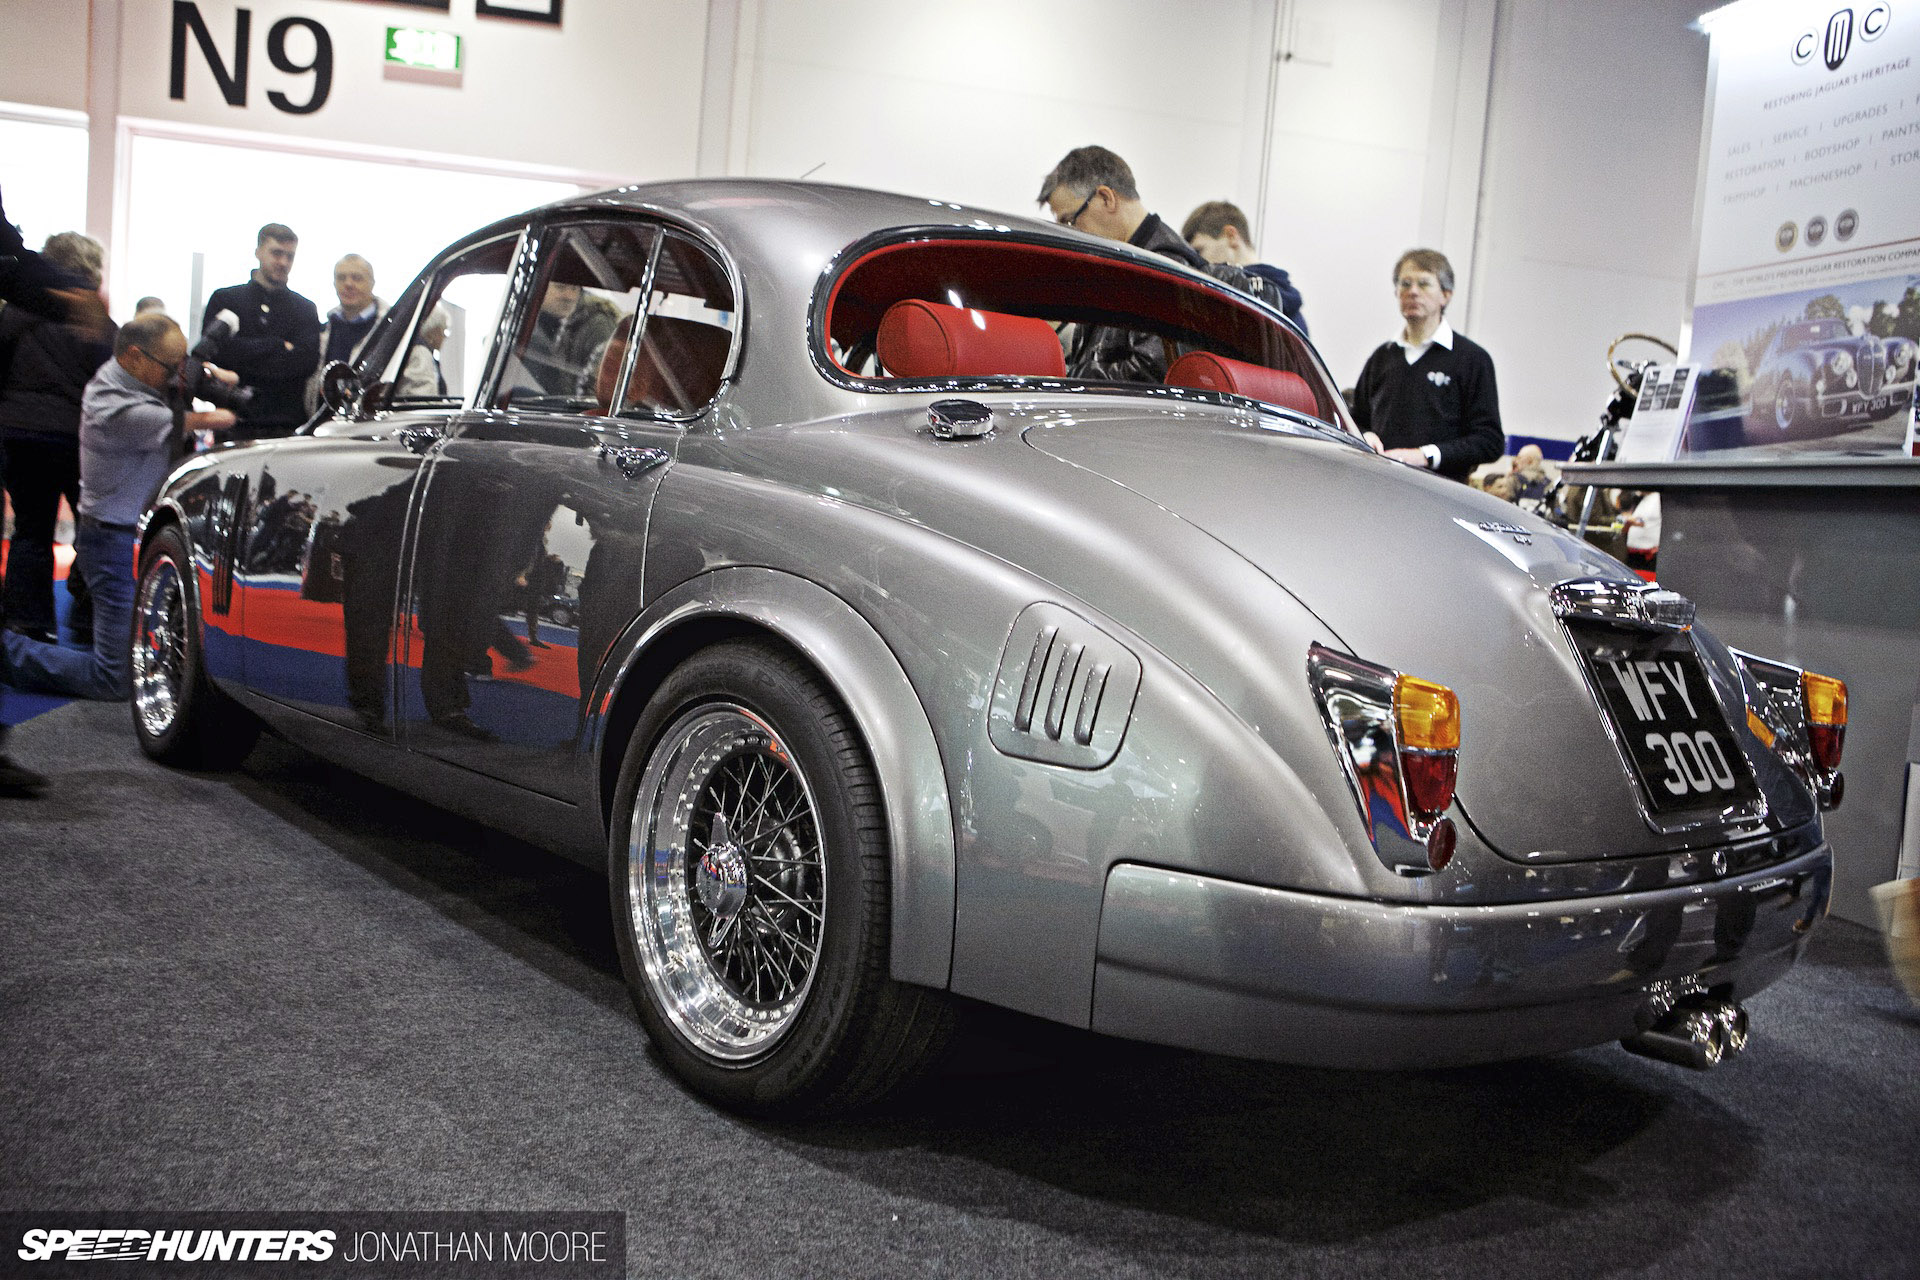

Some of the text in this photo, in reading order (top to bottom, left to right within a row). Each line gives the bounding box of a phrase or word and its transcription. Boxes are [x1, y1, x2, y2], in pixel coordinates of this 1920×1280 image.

[169, 0, 333, 115] N9
[1763, 57, 1911, 110] RESTORING JAGUAR'S HERITAGE
[1727, 103, 1888, 158] SALES SERVICE UPGRADES
[1724, 157, 1785, 181] RESTORATION
[1804, 137, 1860, 162] BODYSHOP
[1789, 162, 1863, 190] MACHINESHOP
[1805, 262, 1832, 275] JAGUAR
[1833, 254, 1886, 270] RESTORATION
[1610, 660, 1698, 722] WFY
[1645, 730, 1736, 795] 300
